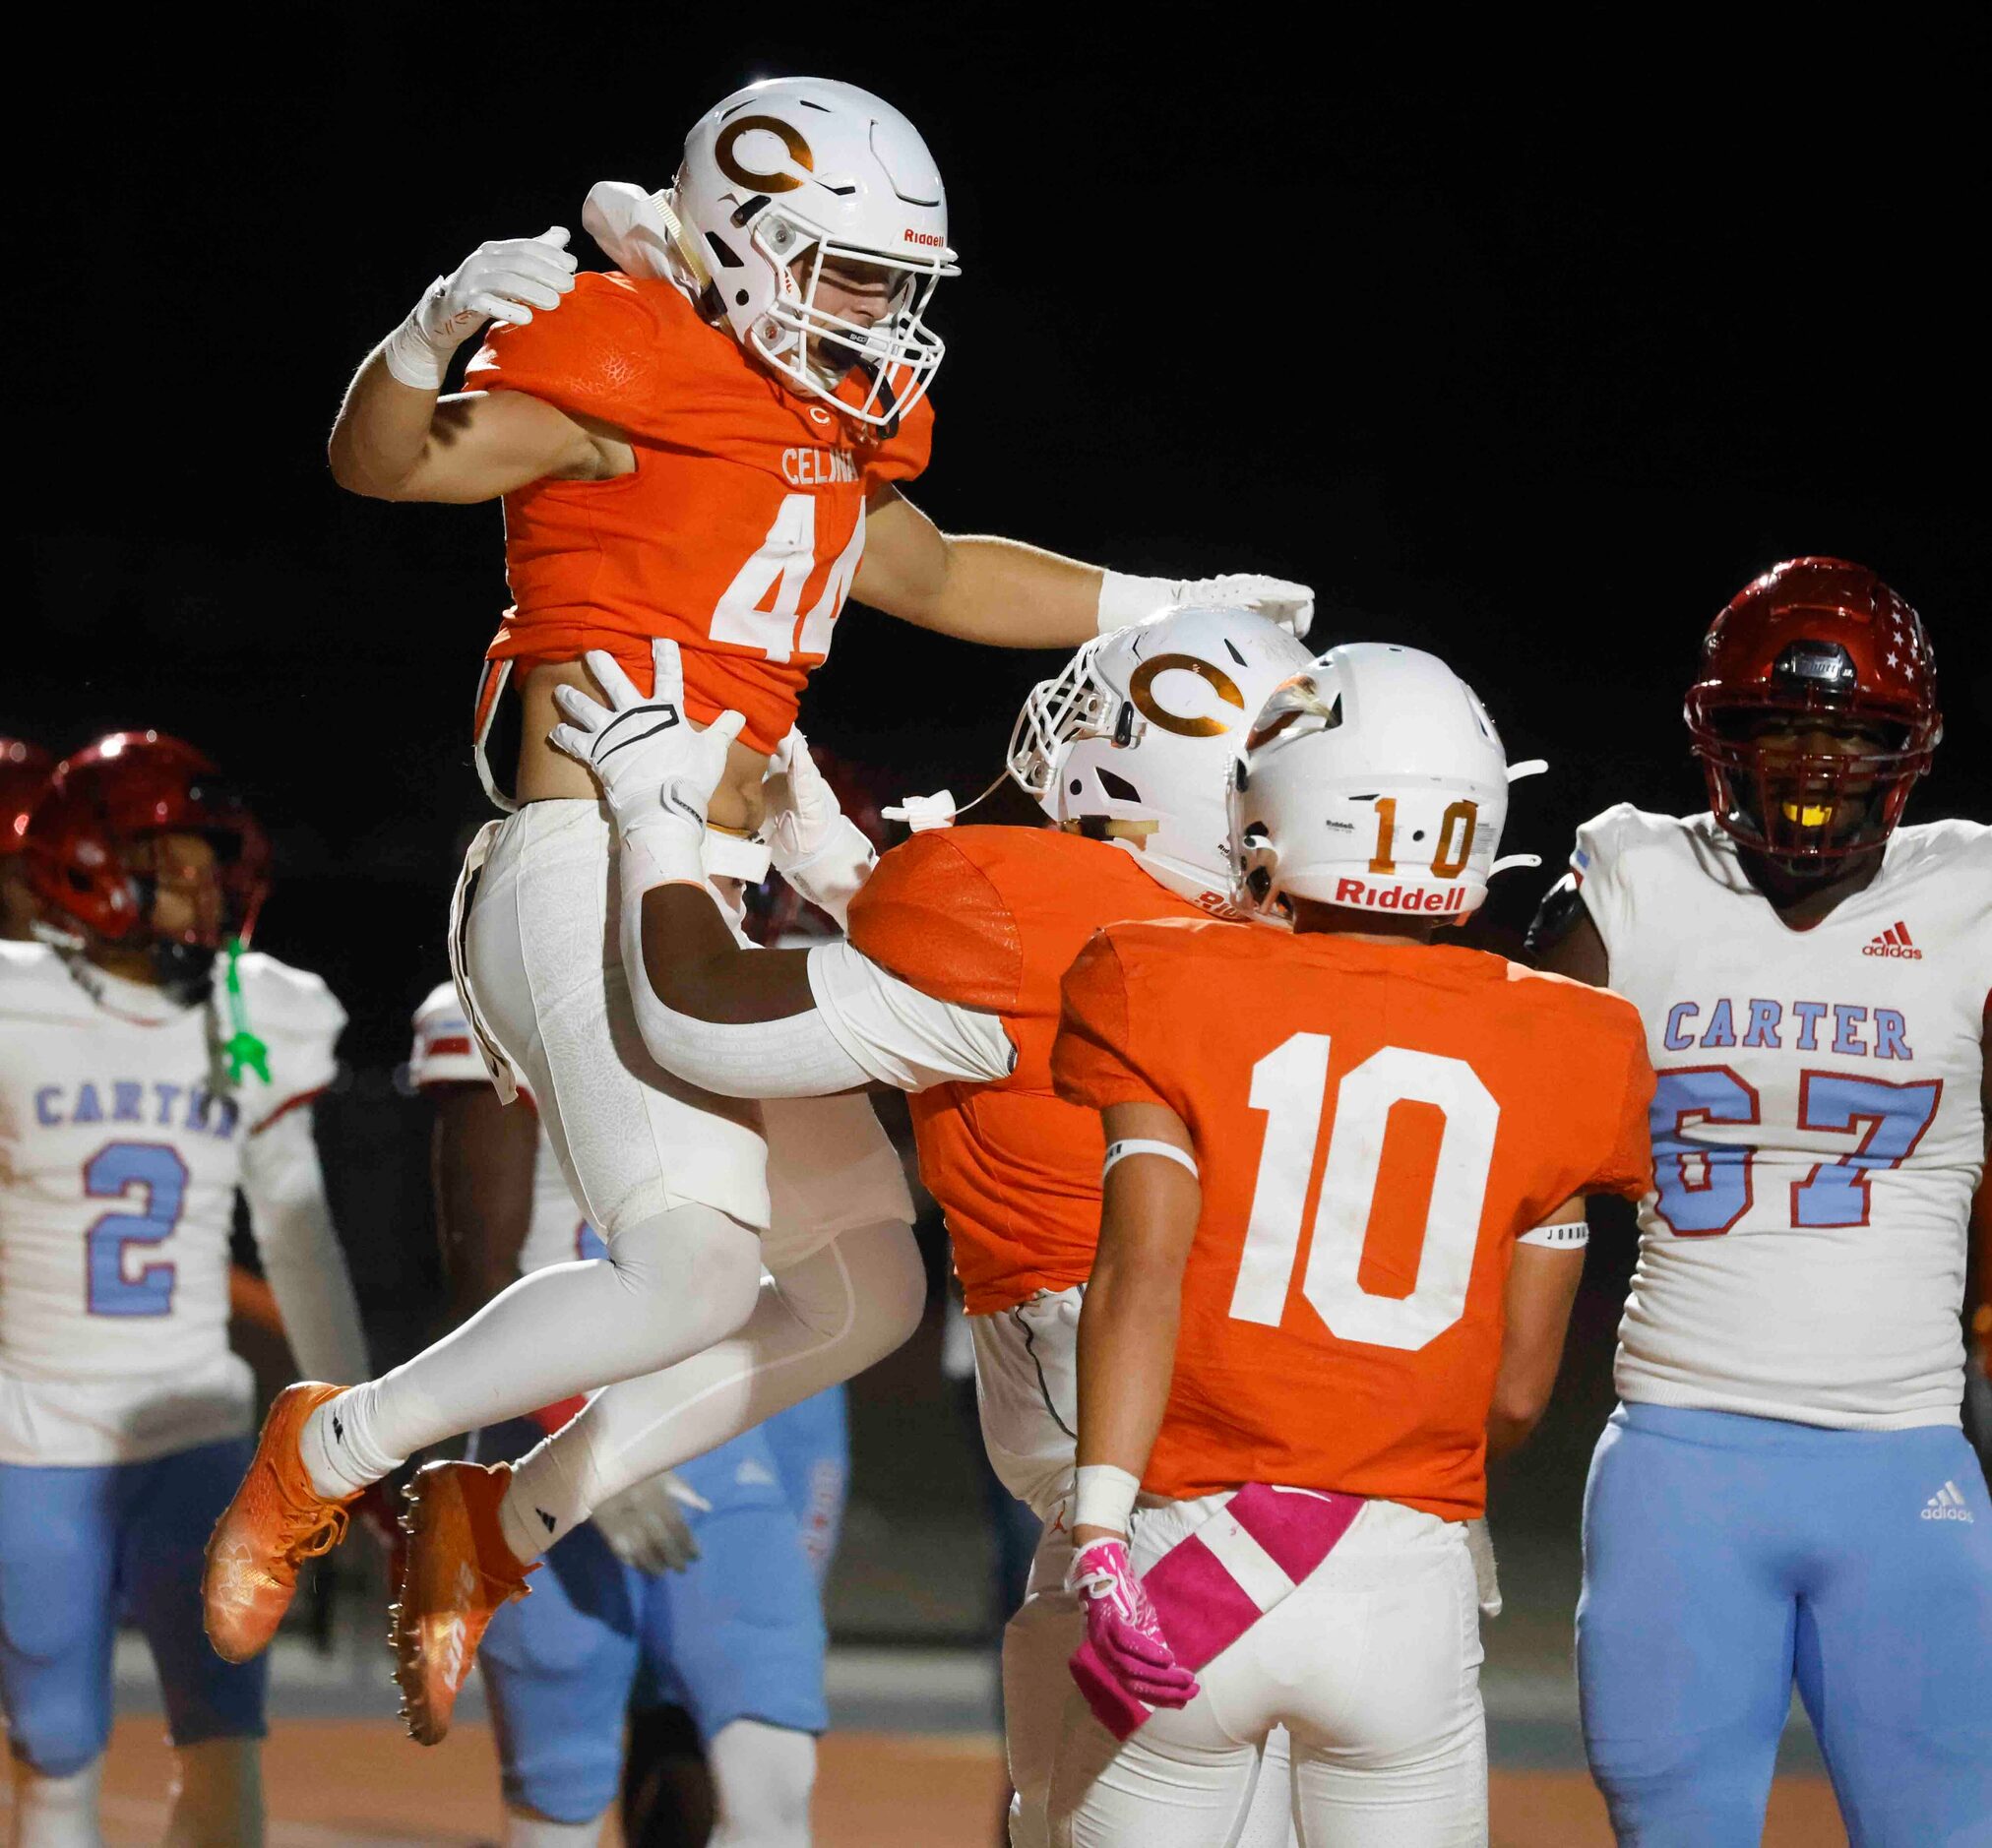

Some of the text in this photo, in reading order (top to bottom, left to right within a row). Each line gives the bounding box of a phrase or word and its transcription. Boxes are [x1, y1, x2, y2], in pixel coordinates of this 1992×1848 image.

[903, 228, 945, 248] Riddell
[809, 407, 831, 424] C
[709, 494, 866, 669] 44
[1336, 878, 1465, 911] Riddell
[1861, 944, 1923, 960] adidas
[1663, 998, 1913, 1061] CARTER
[1648, 1065, 1944, 1237] 67
[1228, 1031, 1501, 1352] 10
[83, 1141, 189, 1317] 2
[1920, 1506, 1974, 1524] adidas
